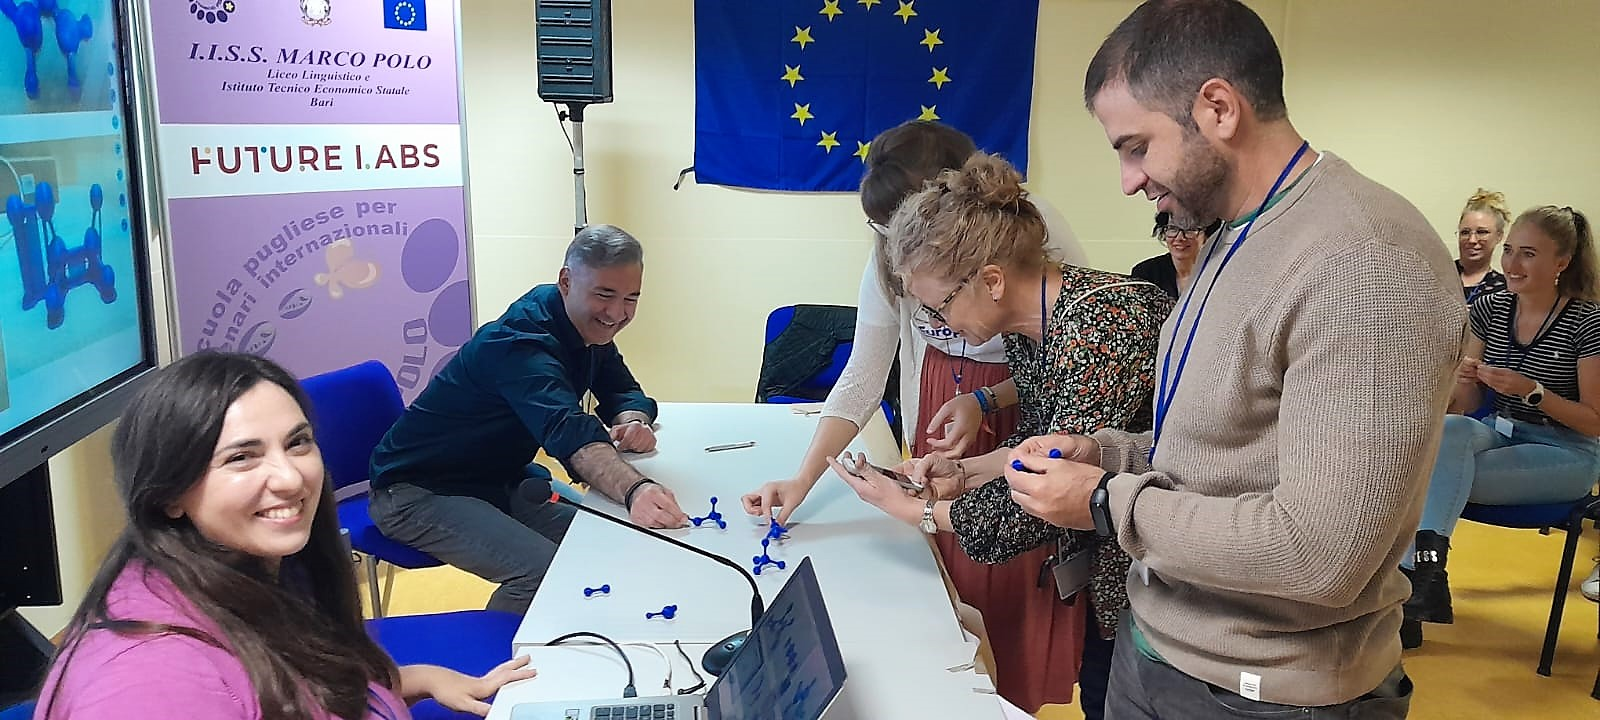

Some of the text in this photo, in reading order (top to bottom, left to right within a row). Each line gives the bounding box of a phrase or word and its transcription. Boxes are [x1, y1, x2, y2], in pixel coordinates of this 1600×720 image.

[187, 42, 432, 70] I.I.S.S. MARCO POLO
[221, 81, 410, 96] Istituto Tecnico Economico Statale
[267, 69, 371, 82] Liceo Linguistico e
[310, 97, 334, 107] Bari
[191, 145, 343, 175] FUTURE
[257, 221, 408, 288] internazionali
[197, 201, 397, 352] cuola pugliese per
[397, 318, 428, 392] OLO
